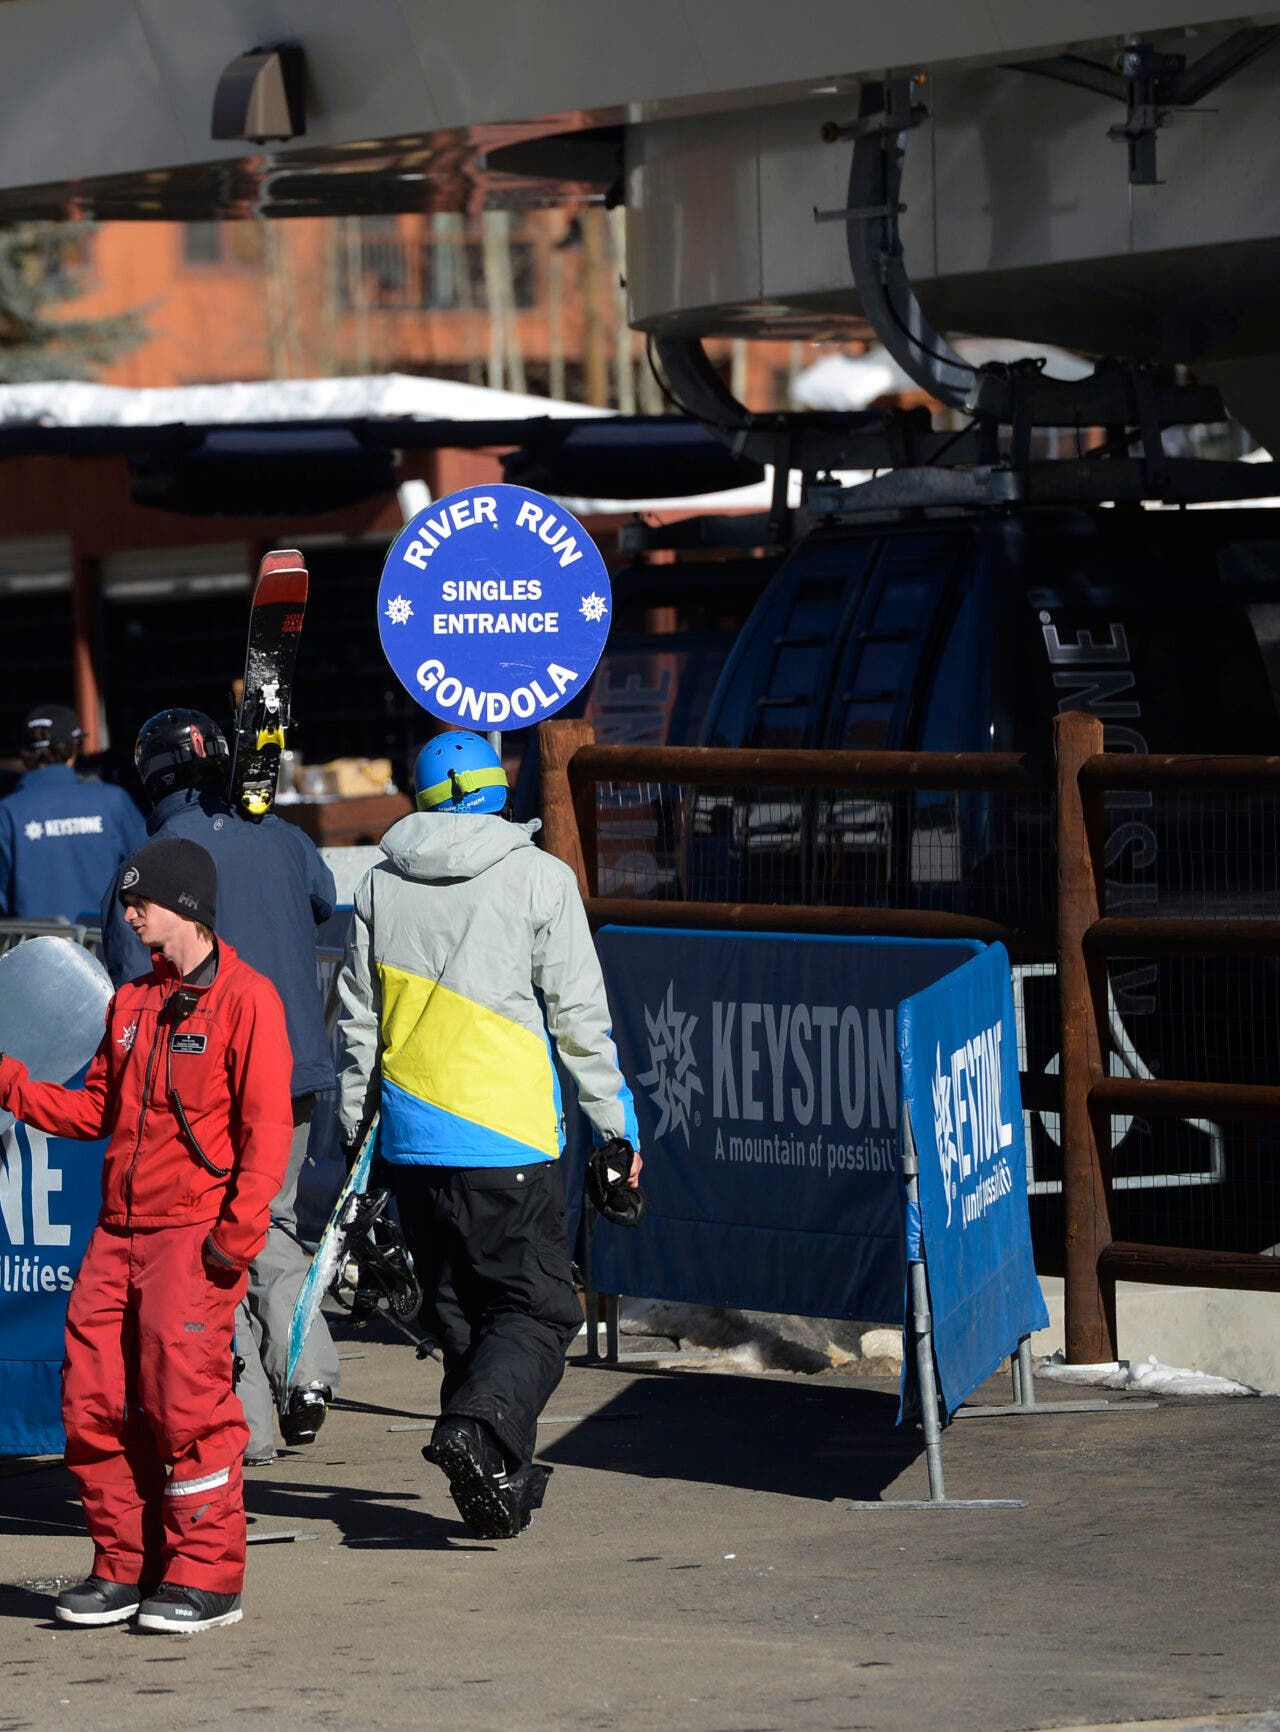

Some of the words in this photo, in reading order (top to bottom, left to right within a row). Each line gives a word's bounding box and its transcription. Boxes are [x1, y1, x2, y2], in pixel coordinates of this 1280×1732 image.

[402, 496, 498, 571] RIVER
[515, 501, 583, 569] RUN
[441, 579, 542, 601] SINGLES
[433, 612, 559, 634] ENTRANCE
[416, 658, 579, 723] GONDOLA
[44, 815, 104, 837] KEYSTONE
[714, 1127, 725, 1161] A
[729, 1132, 806, 1167] mountain
[809, 1134, 823, 1168] of
